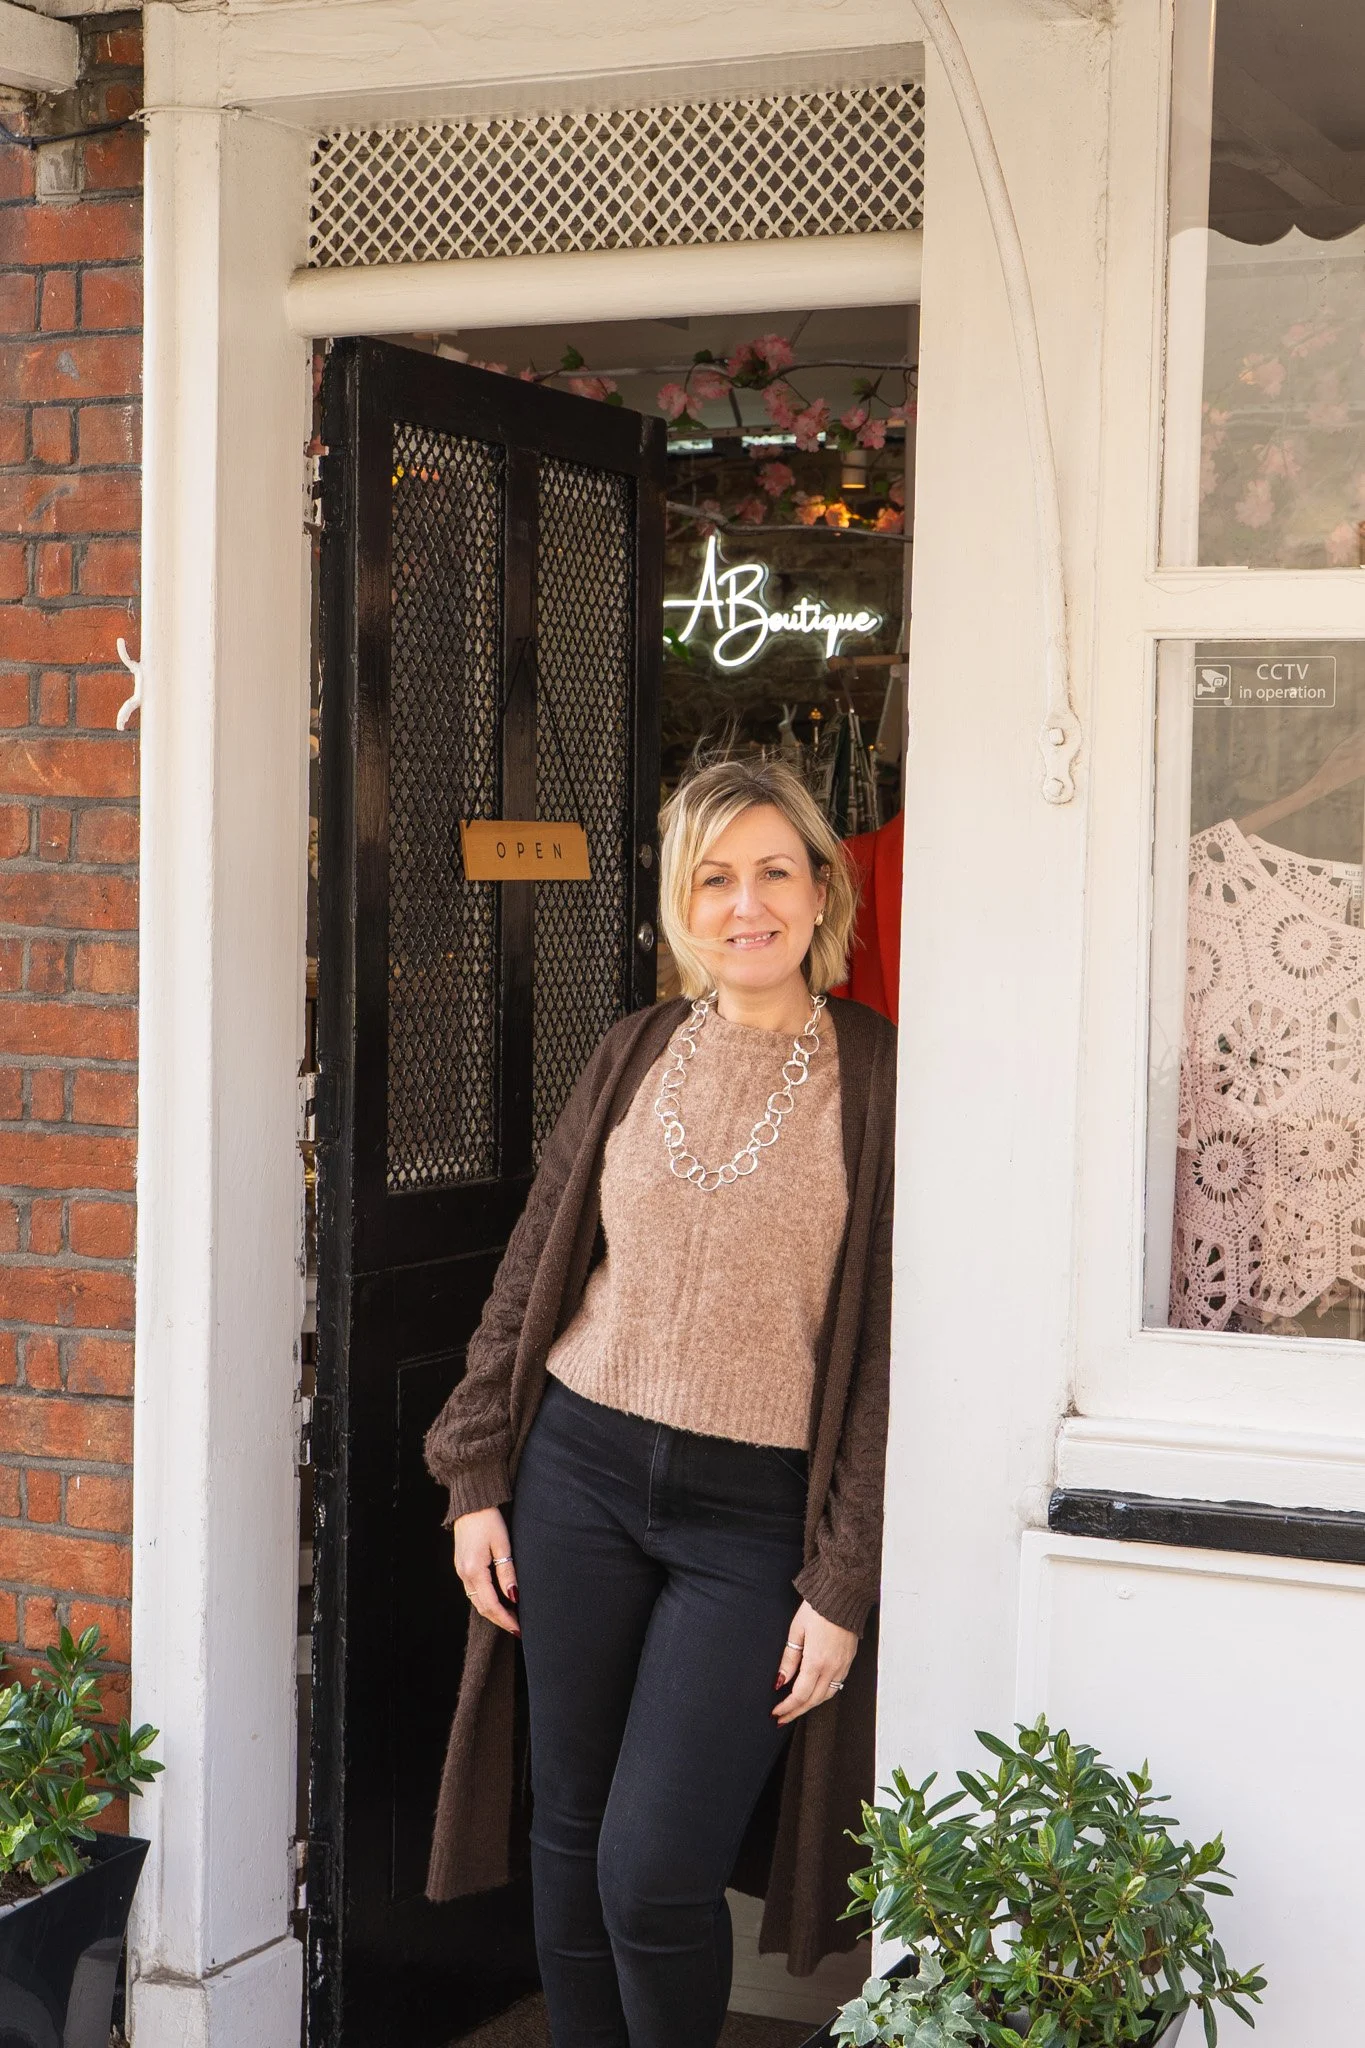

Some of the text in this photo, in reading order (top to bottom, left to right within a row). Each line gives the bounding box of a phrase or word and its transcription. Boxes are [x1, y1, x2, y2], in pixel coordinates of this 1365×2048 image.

[1256, 663, 1309, 680] CCTV
[1239, 685, 1326, 701] in operation
[496, 842, 562, 859] OPEN
